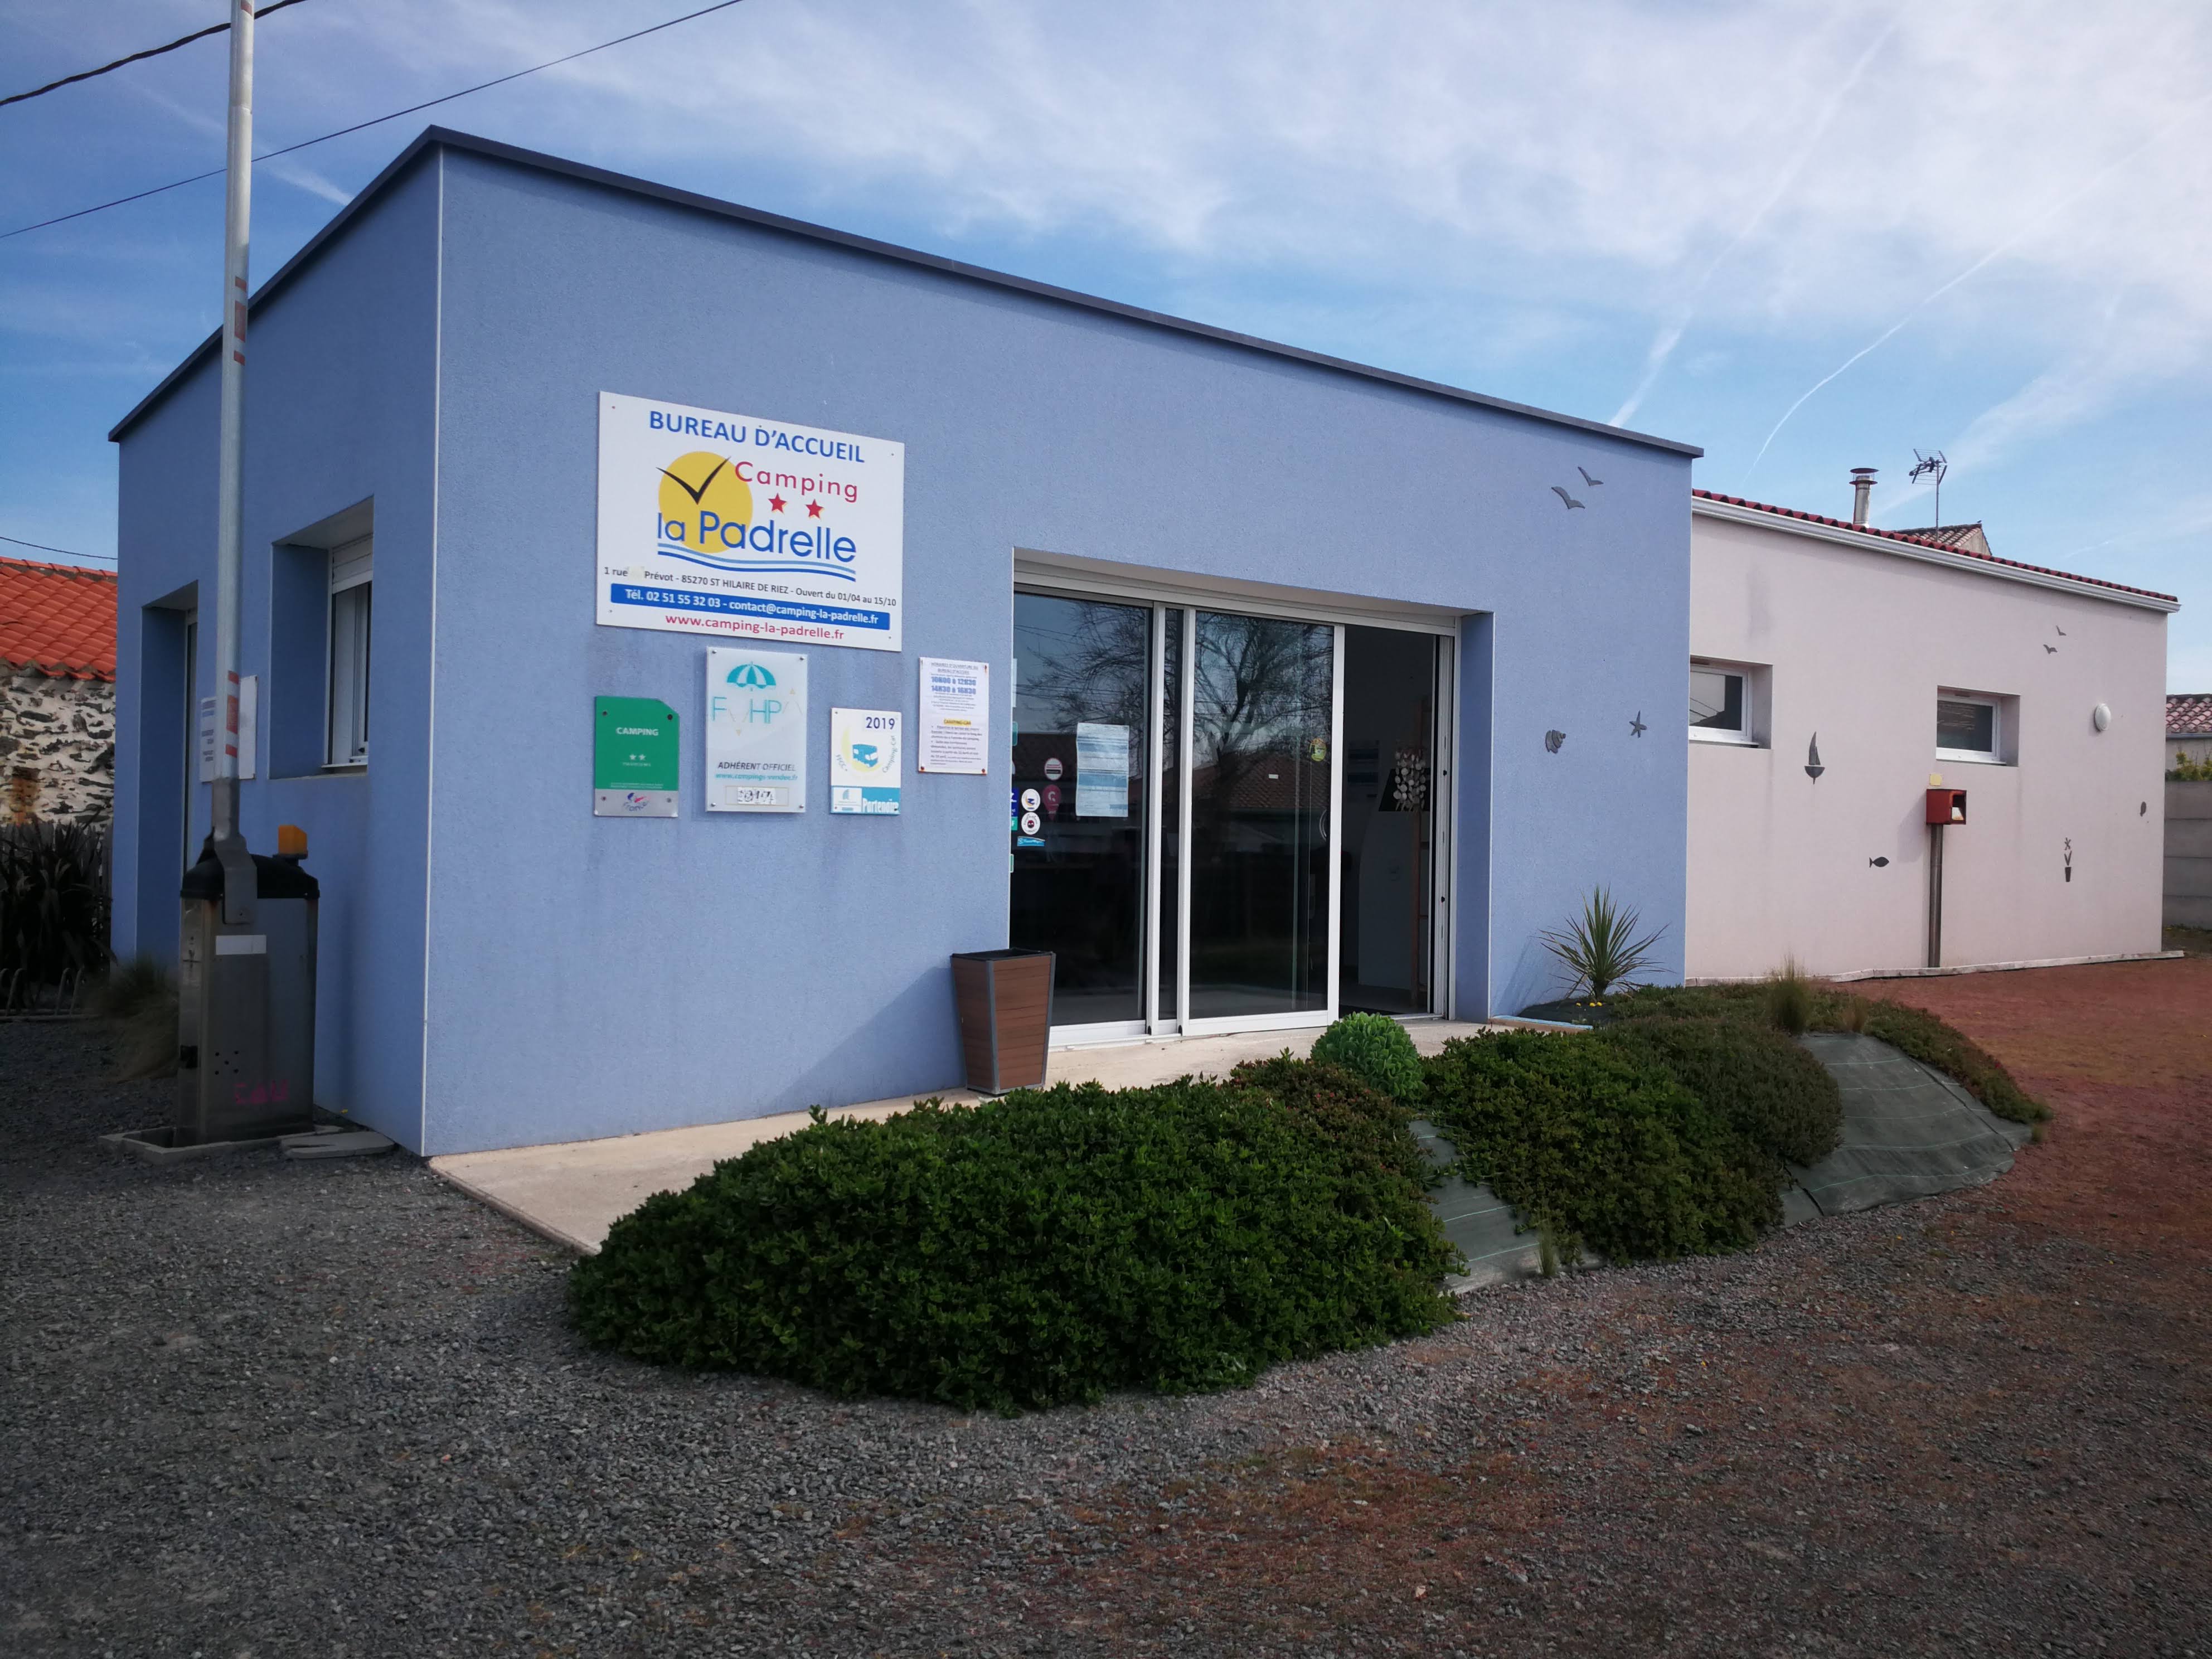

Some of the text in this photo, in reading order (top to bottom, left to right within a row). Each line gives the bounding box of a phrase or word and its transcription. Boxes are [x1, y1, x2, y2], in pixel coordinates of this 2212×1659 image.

[649, 410, 865, 463] BUREAU D'ACCUEIL
[735, 461, 858, 503] Camping
[657, 511, 856, 562] la Padrelle
[613, 569, 628, 577] rue
[644, 570, 673, 581] Prévot
[681, 575, 708, 585] 85270
[710, 578, 720, 586] ST
[722, 579, 755, 590] HILAIRE
[758, 583, 769, 592] DE
[771, 585, 789, 594] RIEZ
[796, 588, 823, 598] Ouvert
[826, 591, 835, 599] du
[838, 593, 861, 603] 01/04
[874, 596, 896, 607] 15/10
[624, 589, 644, 600] Tél.
[646, 591, 659, 601] 02
[662, 593, 675, 603] 51
[677, 594, 691, 605] 55
[693, 596, 706, 607] 32
[708, 598, 721, 608] 03
[729, 601, 879, 624] contact@camping-la-padrelle.fr
[666, 615, 844, 639] www.camping-la-padrelle.fr
[615, 727, 659, 736] CAMPING
[866, 717, 895, 730] 2019
[717, 760, 797, 772] ADHÉRENT OFFICIEL
[862, 798, 900, 813] Partenaire
